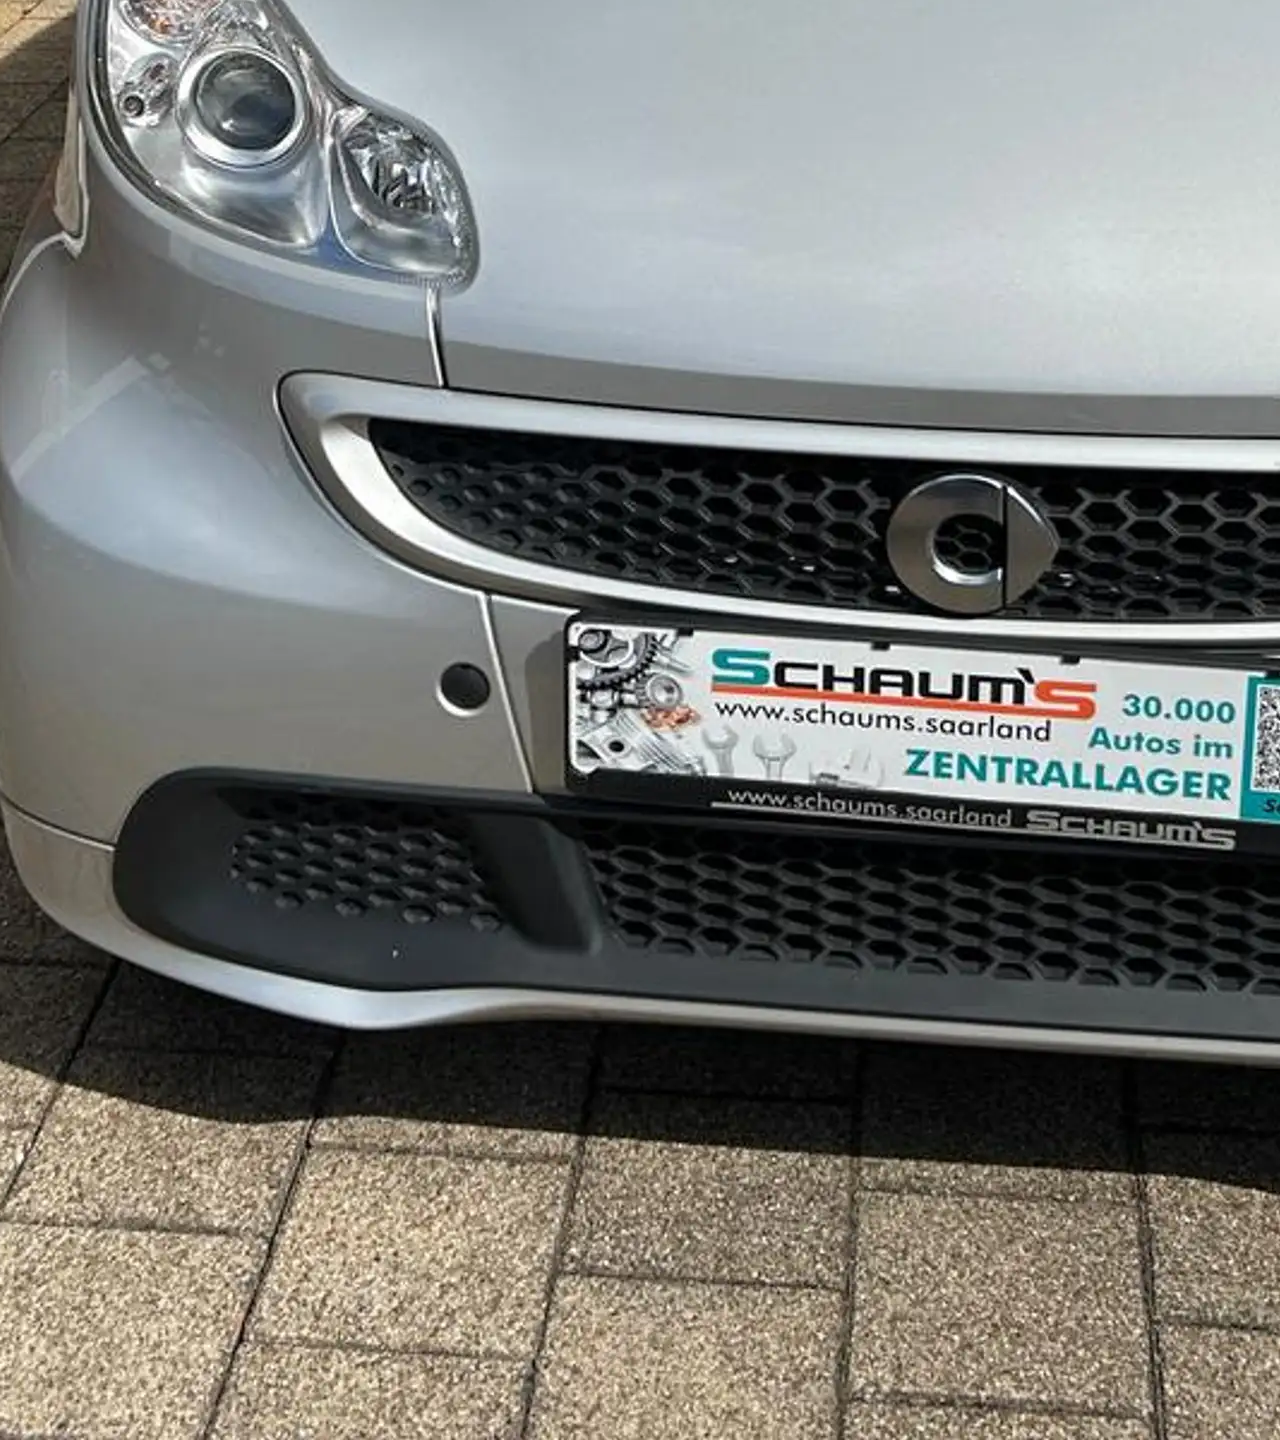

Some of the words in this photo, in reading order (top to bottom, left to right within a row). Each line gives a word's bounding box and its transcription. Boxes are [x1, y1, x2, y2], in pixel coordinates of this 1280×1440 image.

[711, 647, 1097, 721] SCHAUM'S
[715, 699, 1052, 743] www.schaums.saarland
[1122, 694, 1236, 724] 30.000
[1088, 727, 1181, 756] Autos
[1193, 734, 1234, 759] im
[903, 748, 1232, 801] ZENTRALLAGER
[728, 786, 1013, 828] www.schaums.saarland
[1026, 809, 1237, 851] SCHAUM'S
